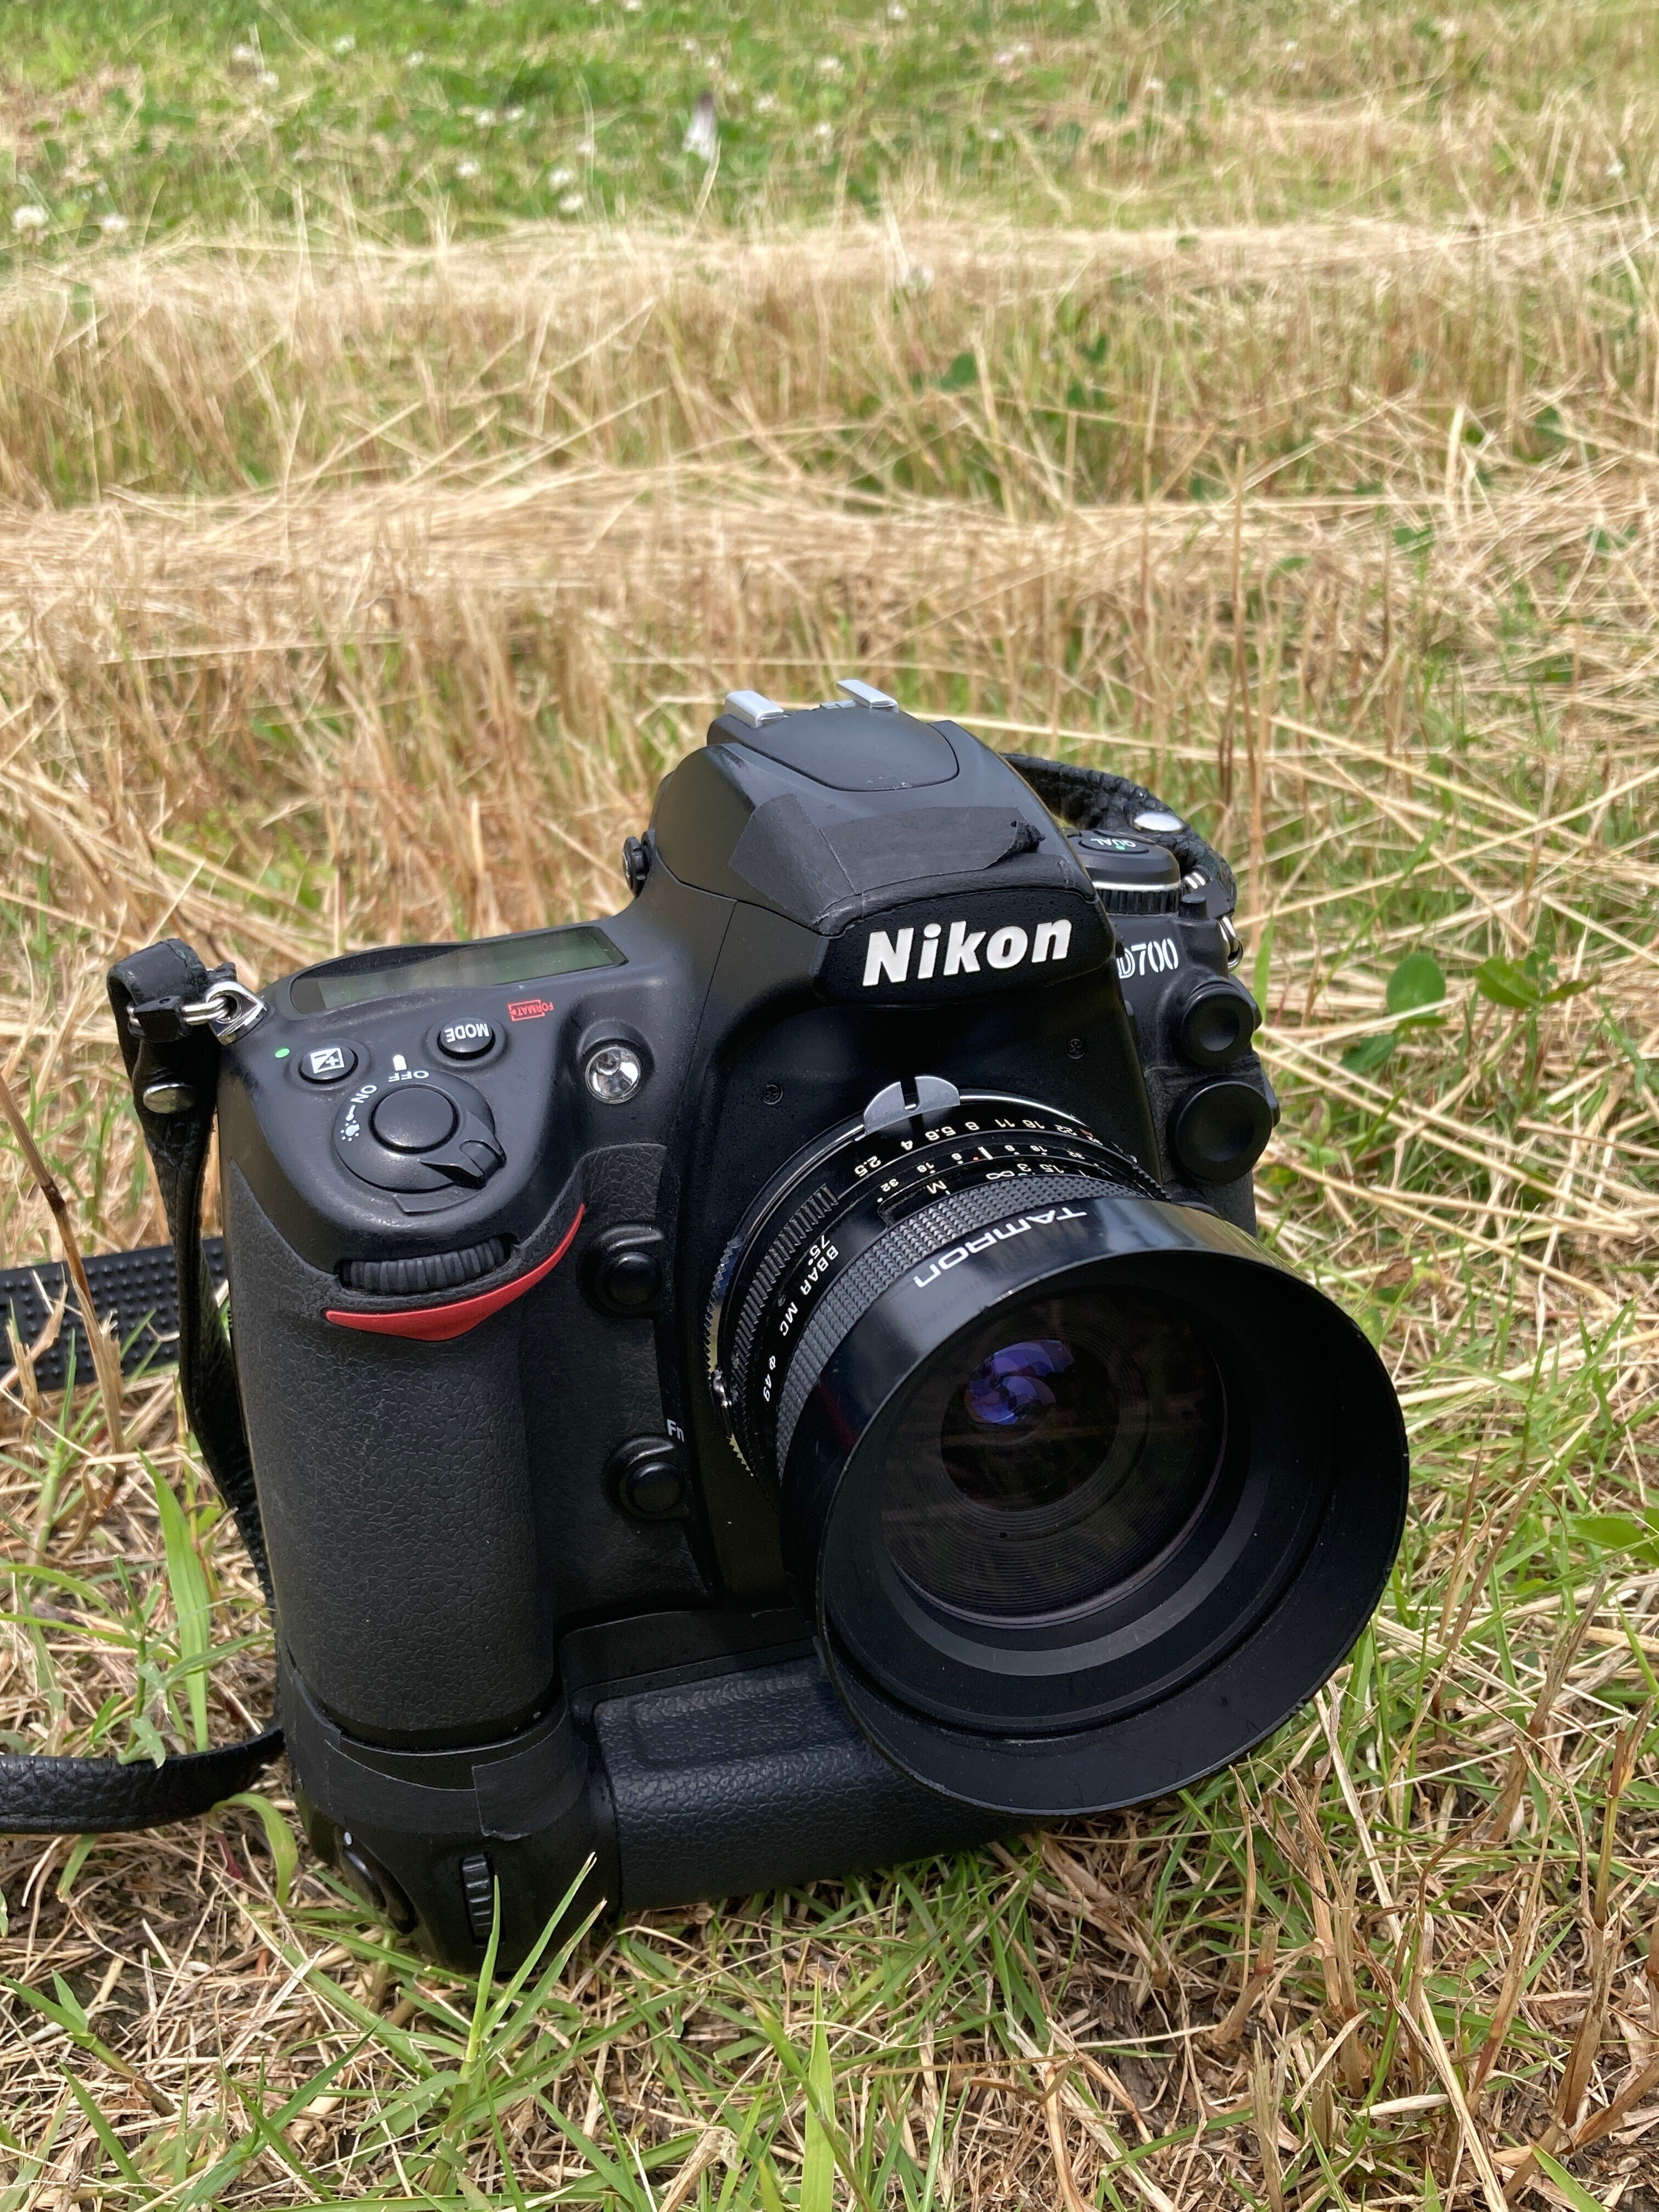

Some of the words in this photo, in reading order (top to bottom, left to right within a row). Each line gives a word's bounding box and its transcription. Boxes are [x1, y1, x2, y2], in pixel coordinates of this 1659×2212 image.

[1090, 838, 1136, 848] QUAL
[862, 919, 1072, 986] Nikon
[1116, 938, 1179, 979] D700
[517, 1001, 554, 1015] FORMAT
[444, 1023, 490, 1043] MODE
[387, 1070, 430, 1083] OFF
[350, 1084, 378, 1104] ON
[964, 1121, 980, 1131] 8
[995, 1119, 1015, 1128] 11
[1022, 1119, 1045, 1130] 16
[1053, 1124, 1077, 1136] 22
[925, 1126, 956, 1142] 5.6
[900, 1140, 913, 1151] 4
[854, 1155, 882, 1178] 2.5
[1017, 1163, 1032, 1172] 3
[1039, 1164, 1065, 1175] 1.5
[880, 1178, 899, 1192] 32
[926, 1180, 947, 1194] M
[913, 1207, 1087, 1288] TAMRON
[800, 1245, 839, 1295] BBAR
[780, 1301, 798, 1336] MC
[667, 1419, 685, 1442] Fn
